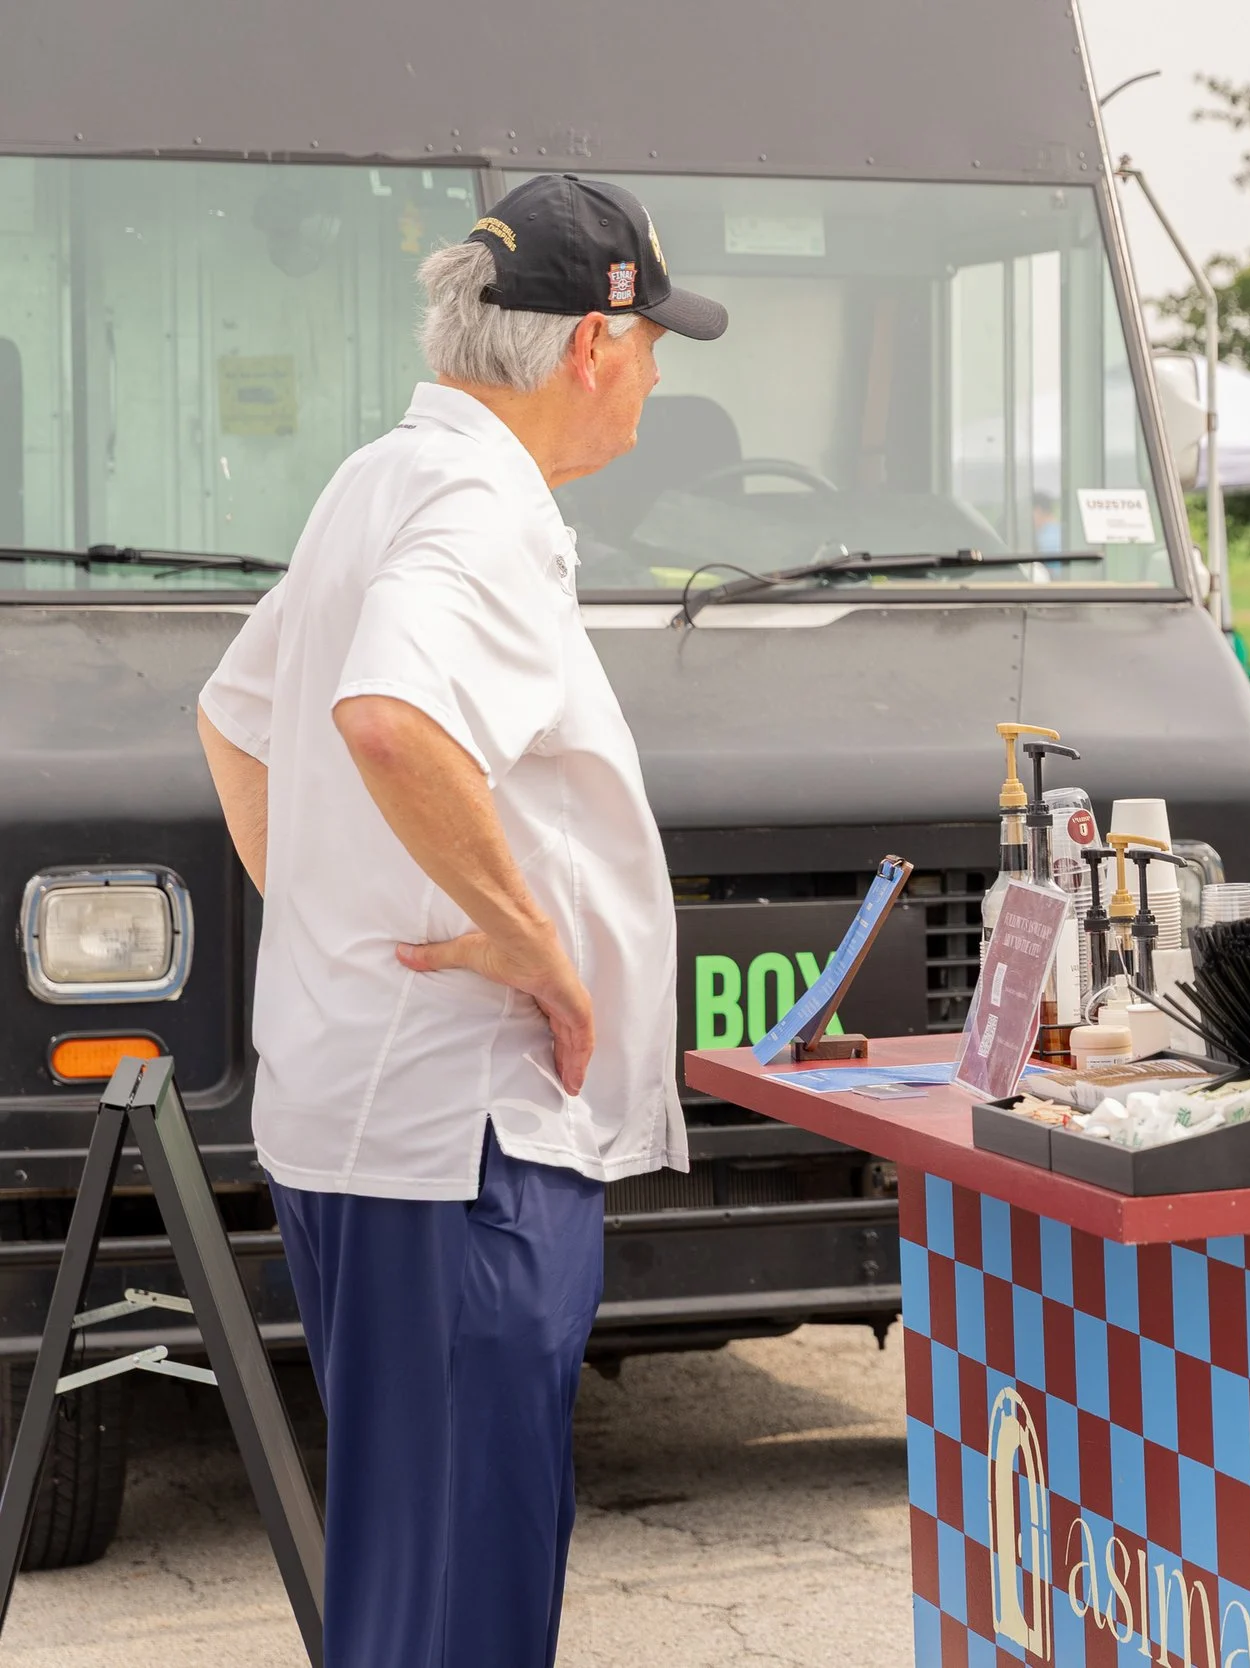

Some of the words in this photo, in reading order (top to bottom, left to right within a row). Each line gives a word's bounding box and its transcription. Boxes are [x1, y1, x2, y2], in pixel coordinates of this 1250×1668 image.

[611, 270, 634, 281] FINAL
[612, 290, 632, 300] FOUR
[696, 951, 845, 1050] BOX
